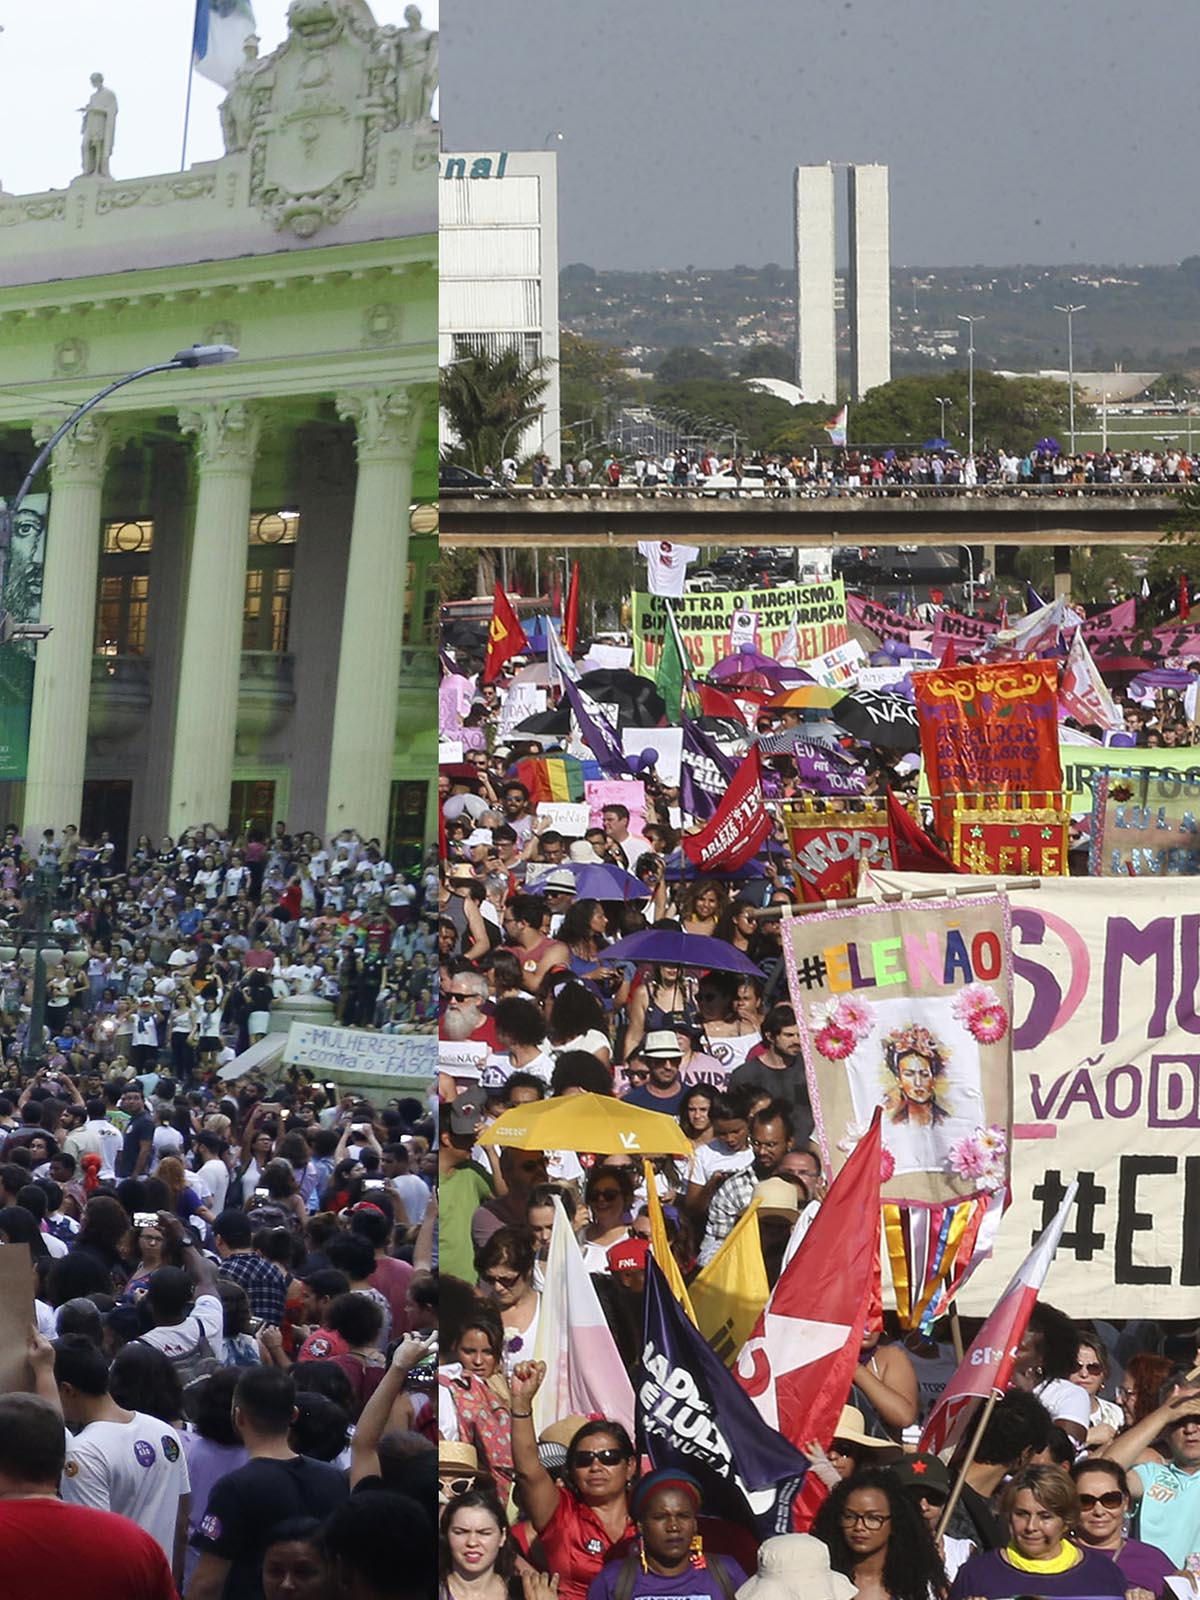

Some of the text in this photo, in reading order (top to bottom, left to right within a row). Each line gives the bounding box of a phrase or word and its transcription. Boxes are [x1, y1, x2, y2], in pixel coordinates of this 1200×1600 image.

[824, 650, 847, 669] ELE
[798, 920, 1001, 993] #ELENÃO
[312, 1029, 396, 1056] MULHERES
[308, 1049, 357, 1069] contra
[1029, 1052, 1142, 1120] VÃO
[618, 1257, 638, 1268] FNL
